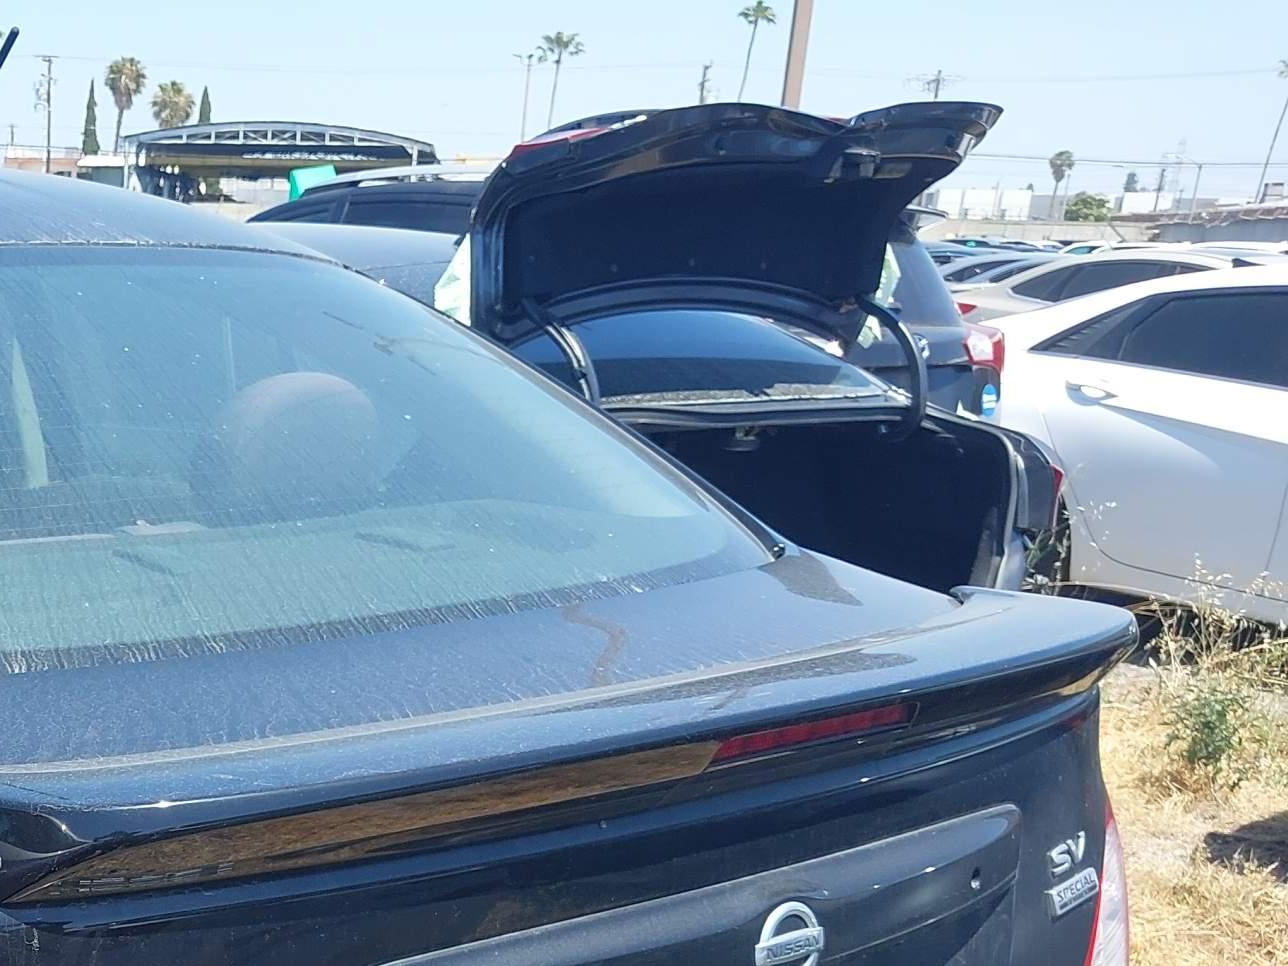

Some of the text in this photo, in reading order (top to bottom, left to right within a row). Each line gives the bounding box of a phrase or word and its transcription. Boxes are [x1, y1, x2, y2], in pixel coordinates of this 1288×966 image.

[1050, 830, 1085, 877] SV
[1056, 871, 1096, 903] SPECIAL
[767, 933, 818, 961] NISSAN
